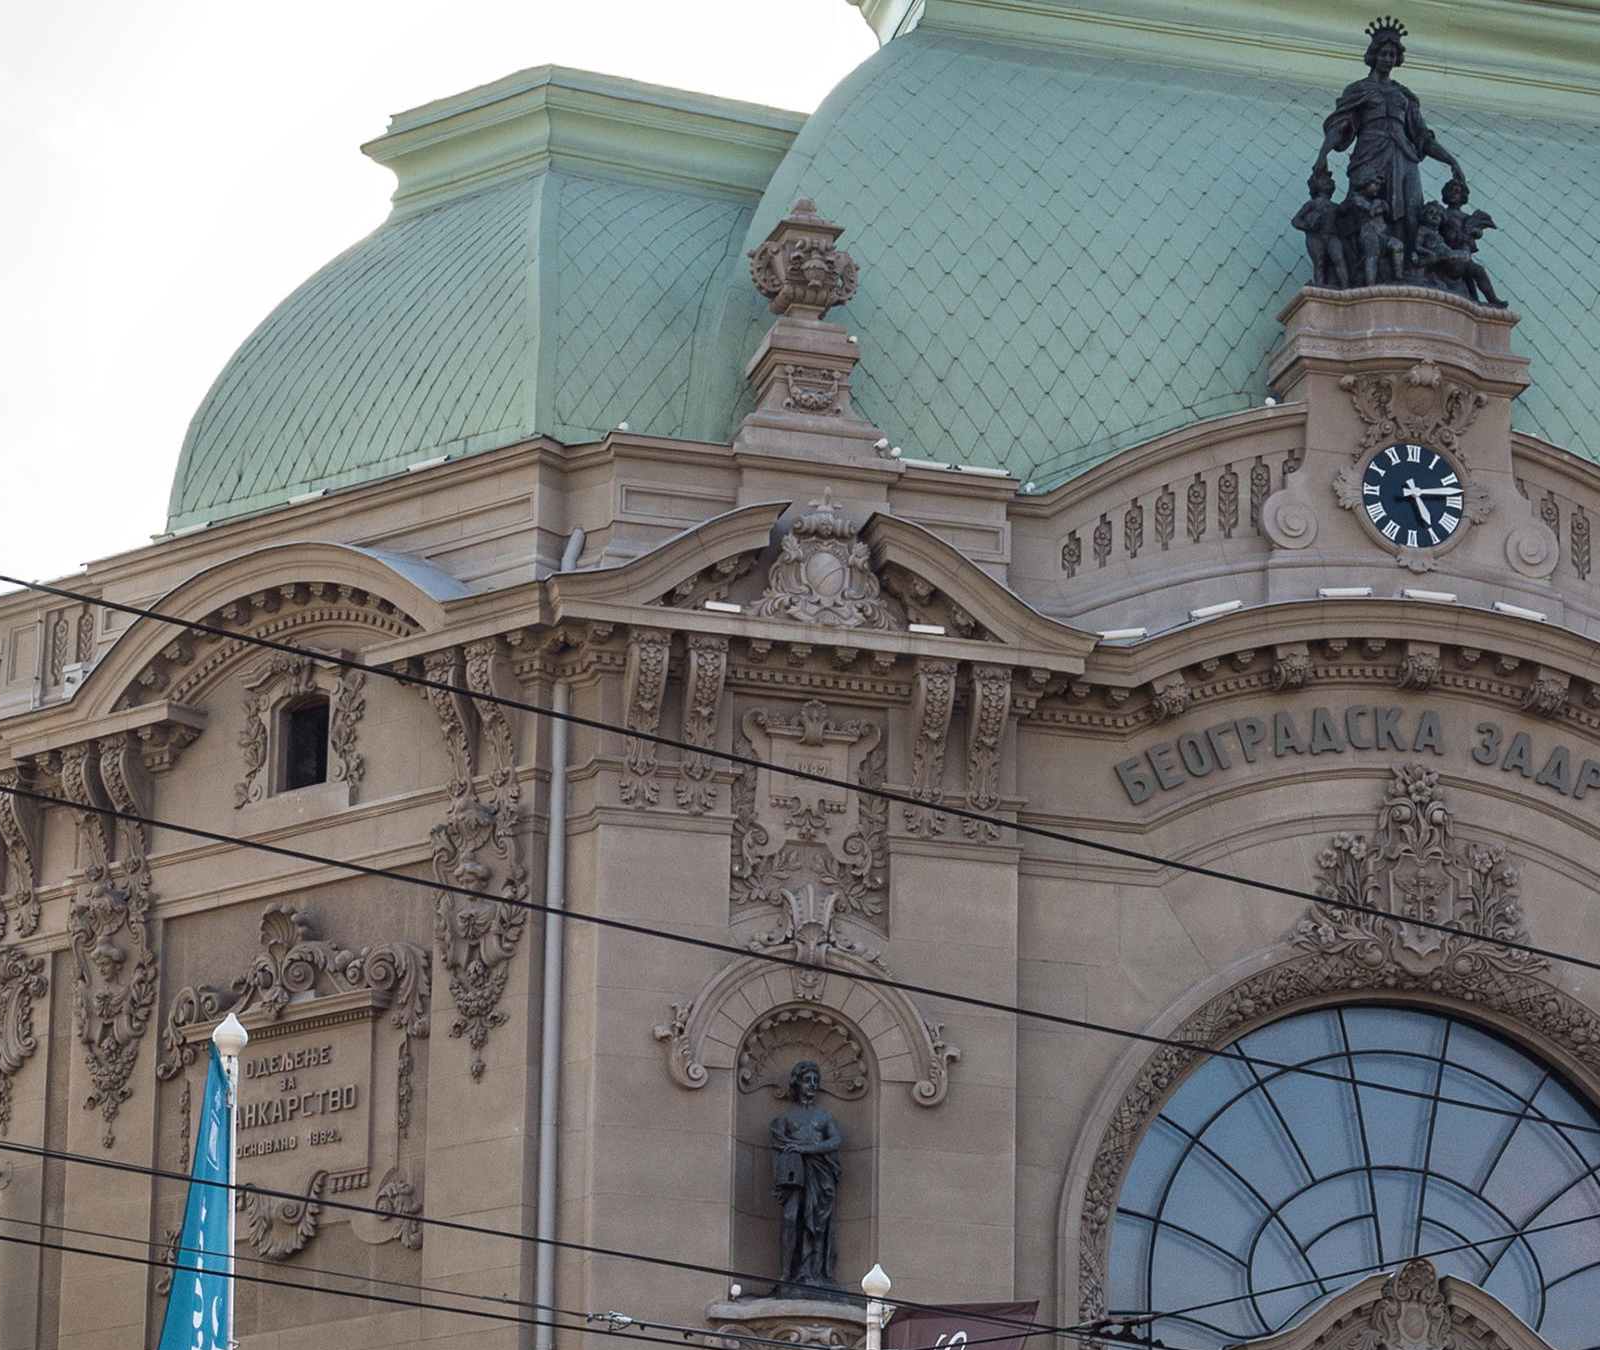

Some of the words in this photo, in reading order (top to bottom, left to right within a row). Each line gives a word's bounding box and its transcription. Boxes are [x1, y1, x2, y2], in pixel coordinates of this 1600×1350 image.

[1113, 704, 1446, 806] БЕОГРАДСКА
[245, 1045, 332, 1080] ОДЕЉЕЊЕ
[280, 1077, 297, 1093] ЗА
[236, 1084, 358, 1130] АНКАРСТВО
